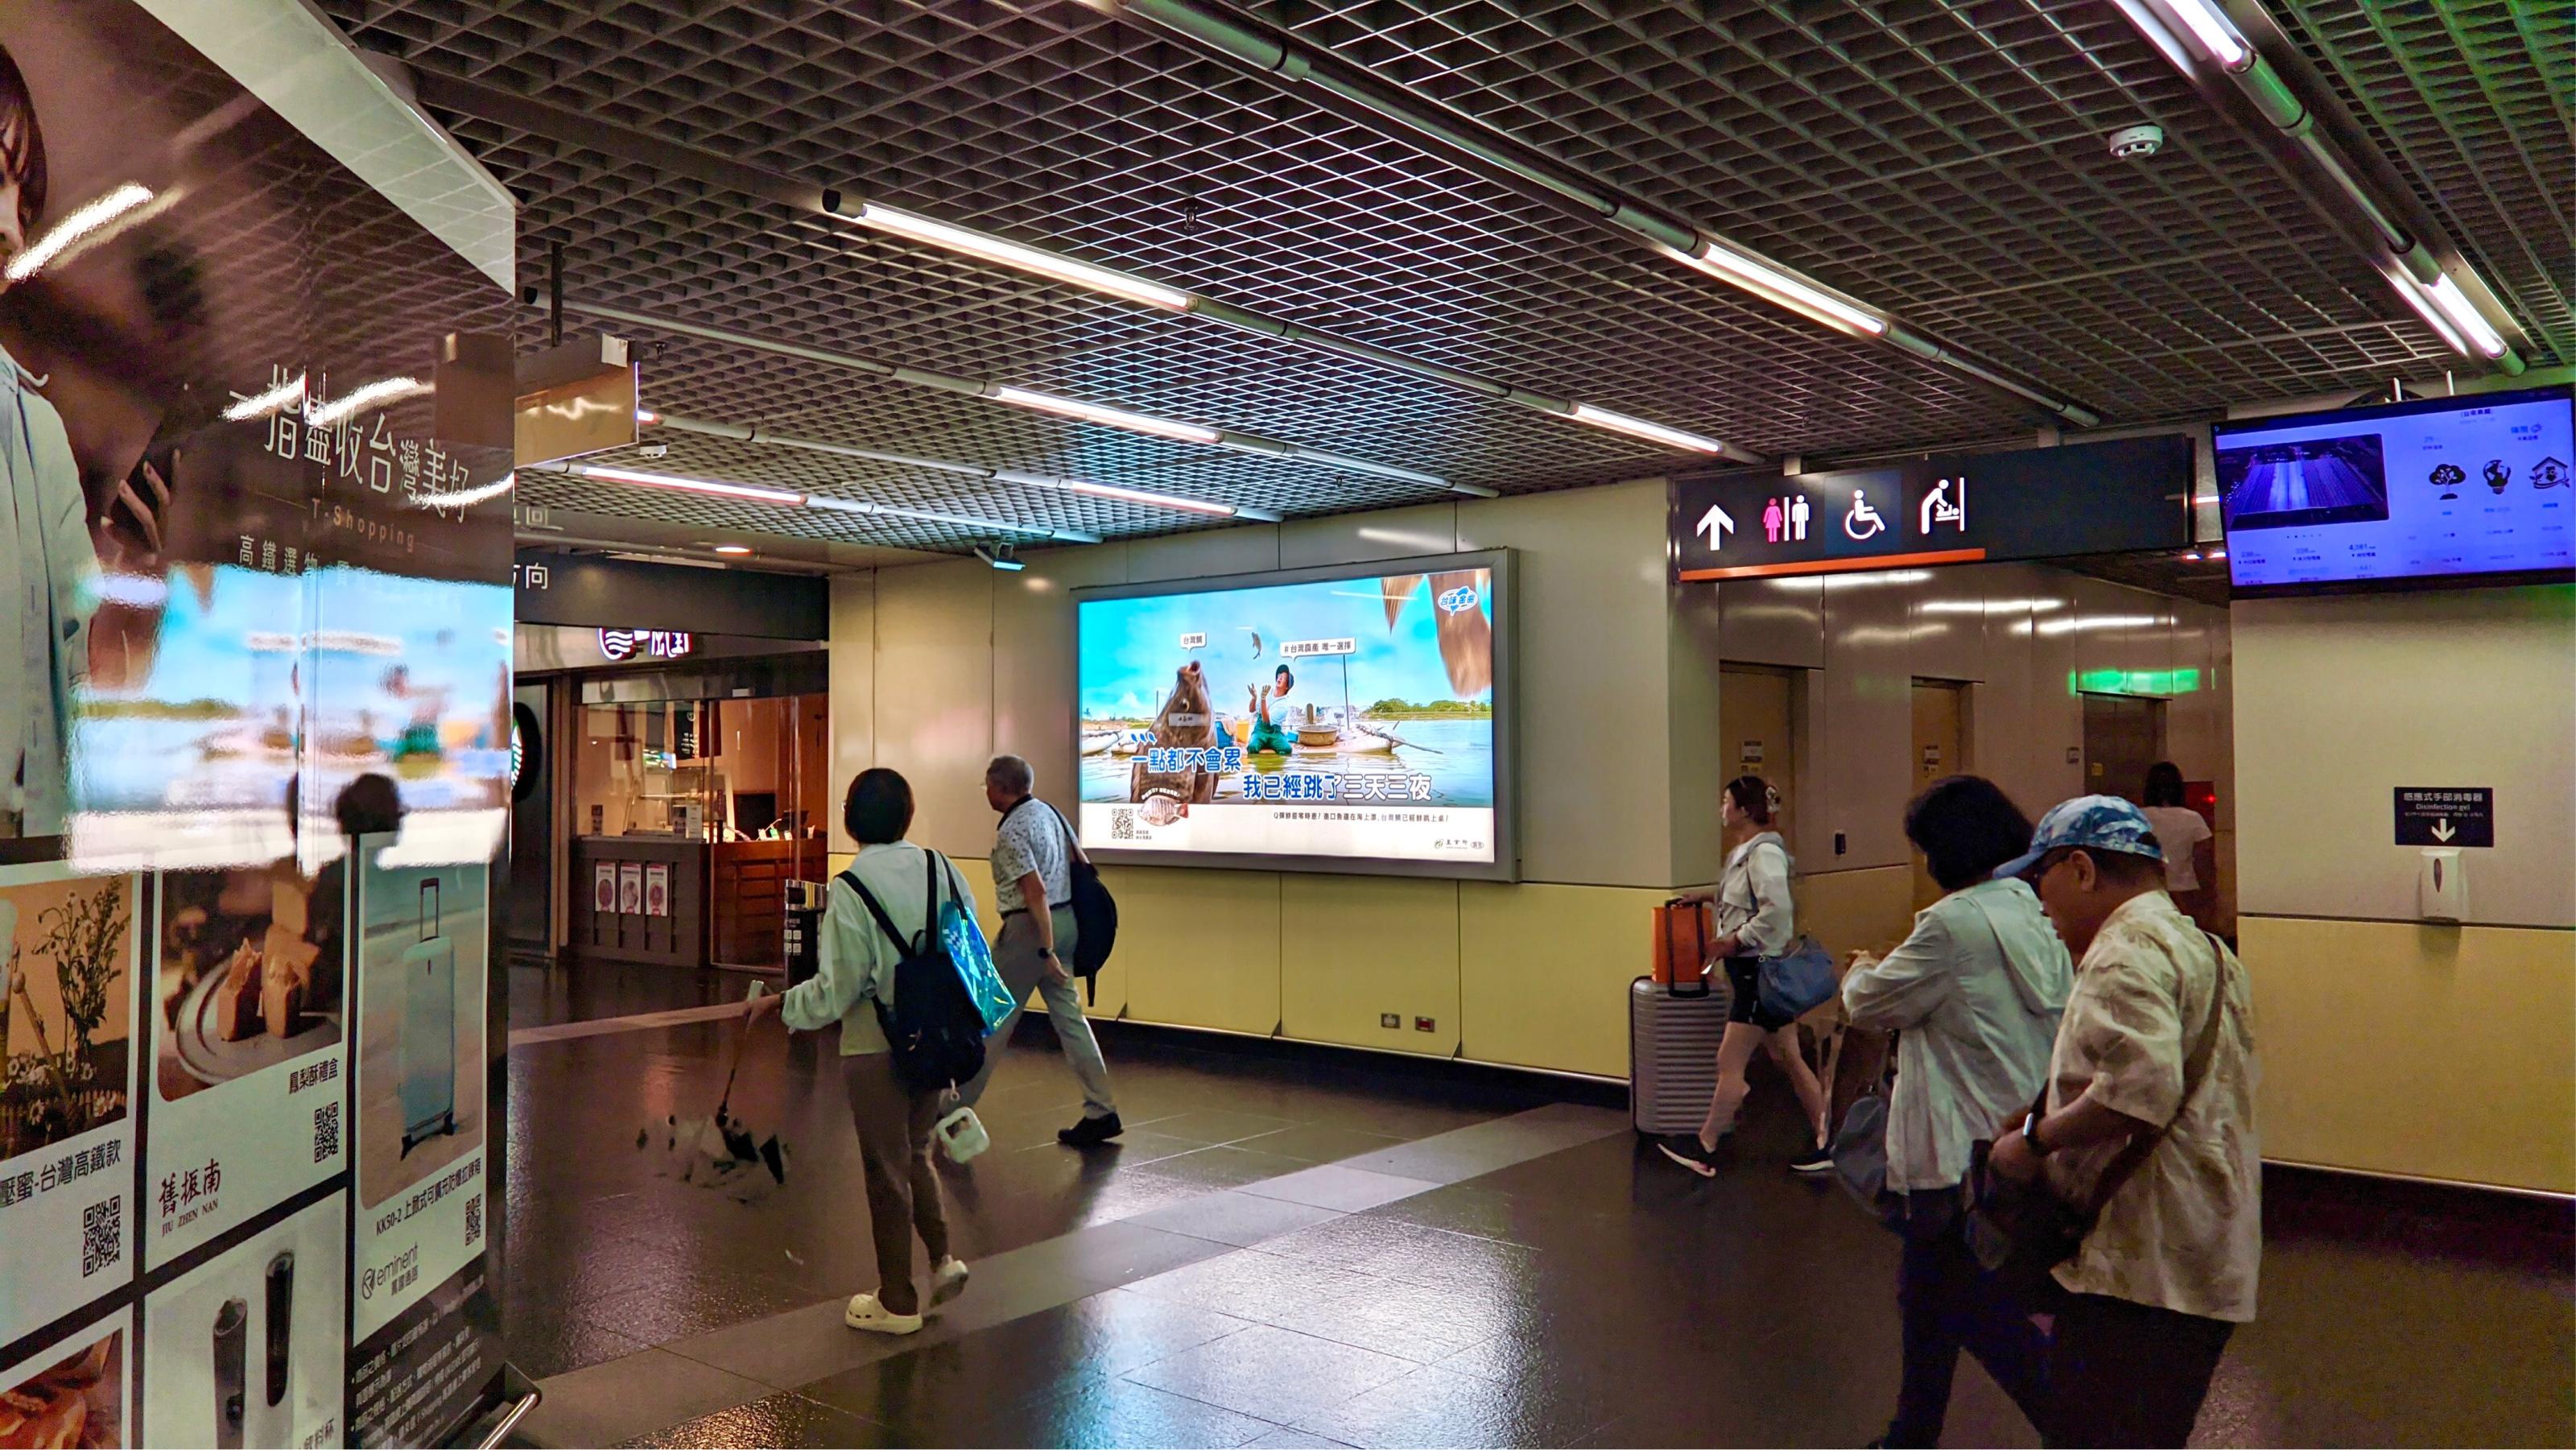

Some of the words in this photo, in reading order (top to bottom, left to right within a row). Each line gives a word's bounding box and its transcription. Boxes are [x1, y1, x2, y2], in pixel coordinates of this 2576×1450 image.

[1131, 748, 1241, 773] 一點都不會累
[1243, 774, 1432, 801] 我已經跳了三天三夜
[2459, 803, 2471, 812] gel
[288, 1057, 339, 1095] 鳳梨酥禮盒
[158, 1158, 221, 1219] 舊振南
[161, 1221, 174, 1238] JIU
[177, 1211, 199, 1229] ZHEN
[202, 1198, 220, 1214] NAN
[376, 1208, 402, 1236] KK50-2
[377, 1241, 419, 1287] eminent
